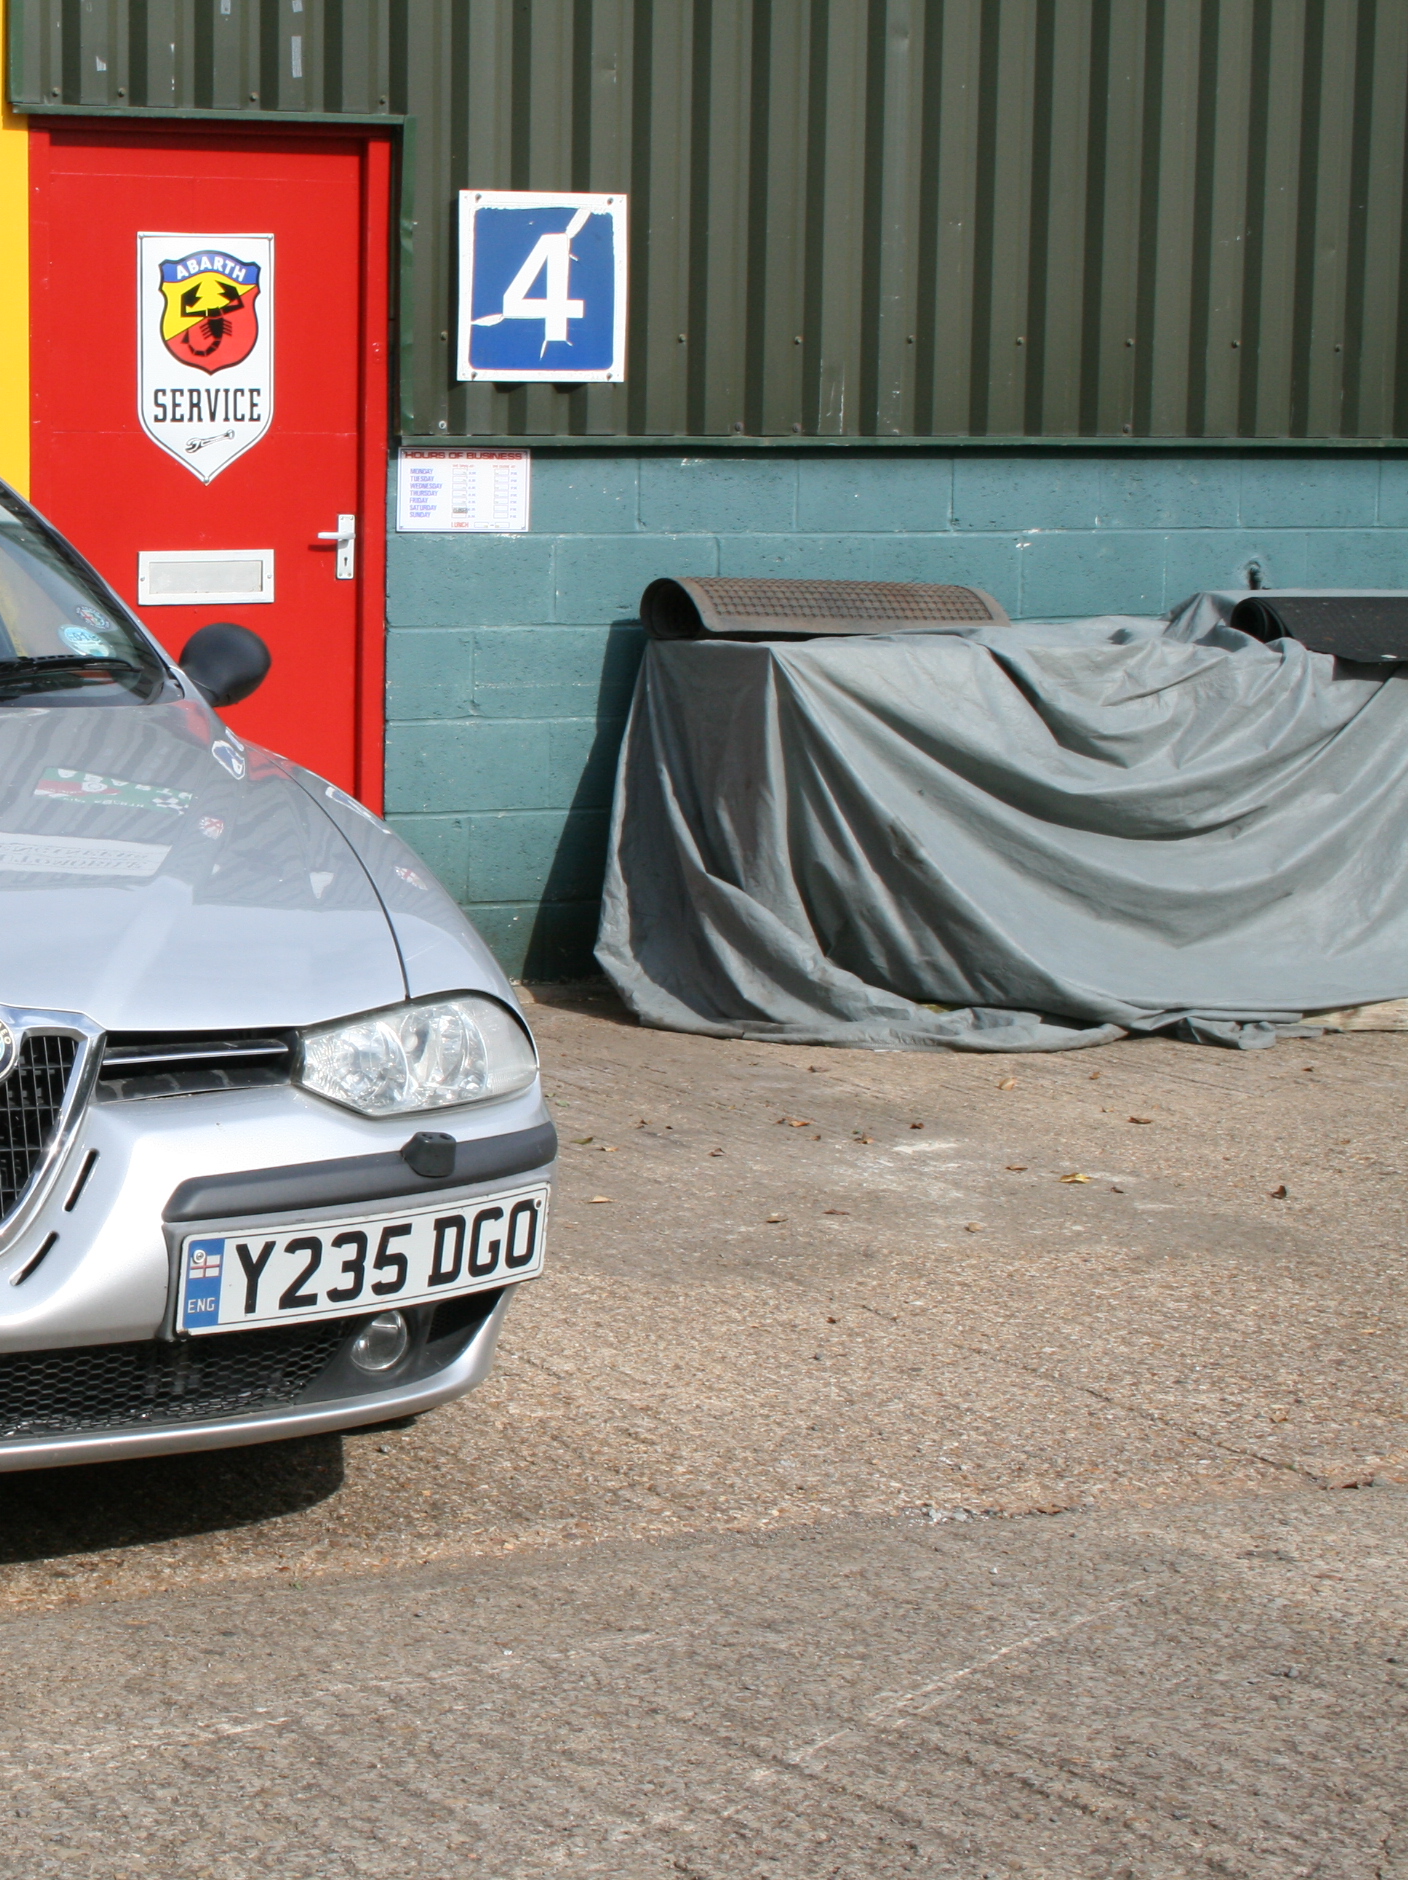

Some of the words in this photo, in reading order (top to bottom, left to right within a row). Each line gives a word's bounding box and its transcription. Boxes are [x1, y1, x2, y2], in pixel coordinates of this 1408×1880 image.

[176, 256, 247, 282] ABARTH
[503, 232, 585, 342] 4
[154, 388, 261, 423] SERVICE
[404, 451, 445, 459] HOURS
[466, 452, 523, 460] BUSINESS
[235, 1223, 412, 1315] Y235
[427, 1199, 536, 1287] DGO
[187, 1297, 215, 1314] ENG
